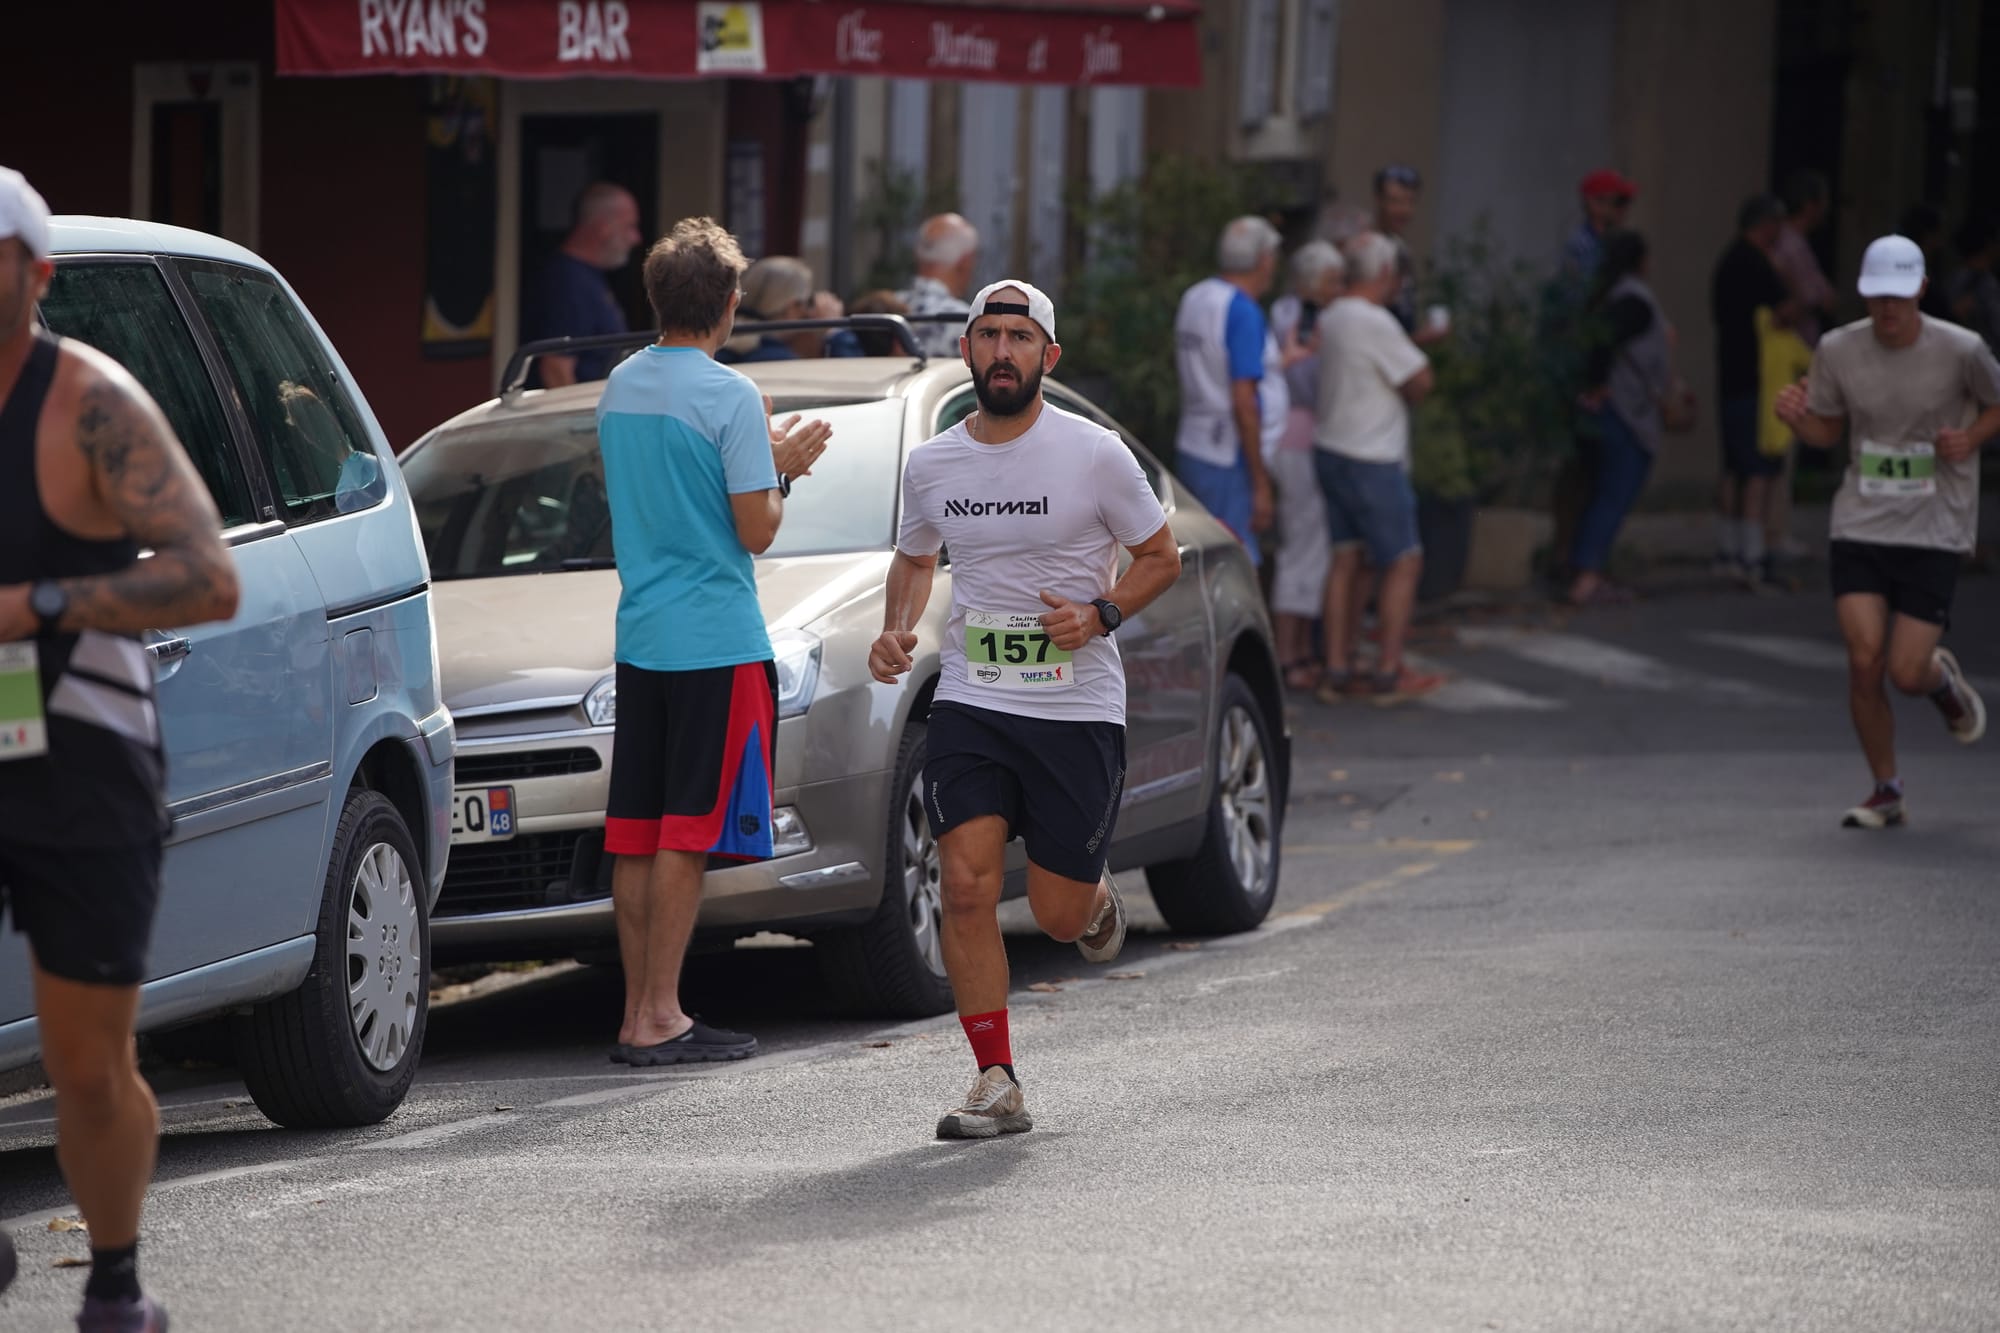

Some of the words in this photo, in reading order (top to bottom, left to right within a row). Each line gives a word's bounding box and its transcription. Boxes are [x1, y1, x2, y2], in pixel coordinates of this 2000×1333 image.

[360, 0, 488, 57] RYAN'S
[557, 1, 631, 61] BAR
[1877, 457, 1911, 479] 41
[944, 496, 1049, 517] Normal
[980, 632, 1051, 664] 157
[977, 669, 998, 678] BFP
[931, 781, 945, 824] SALOMON
[491, 812, 511, 833] 48
